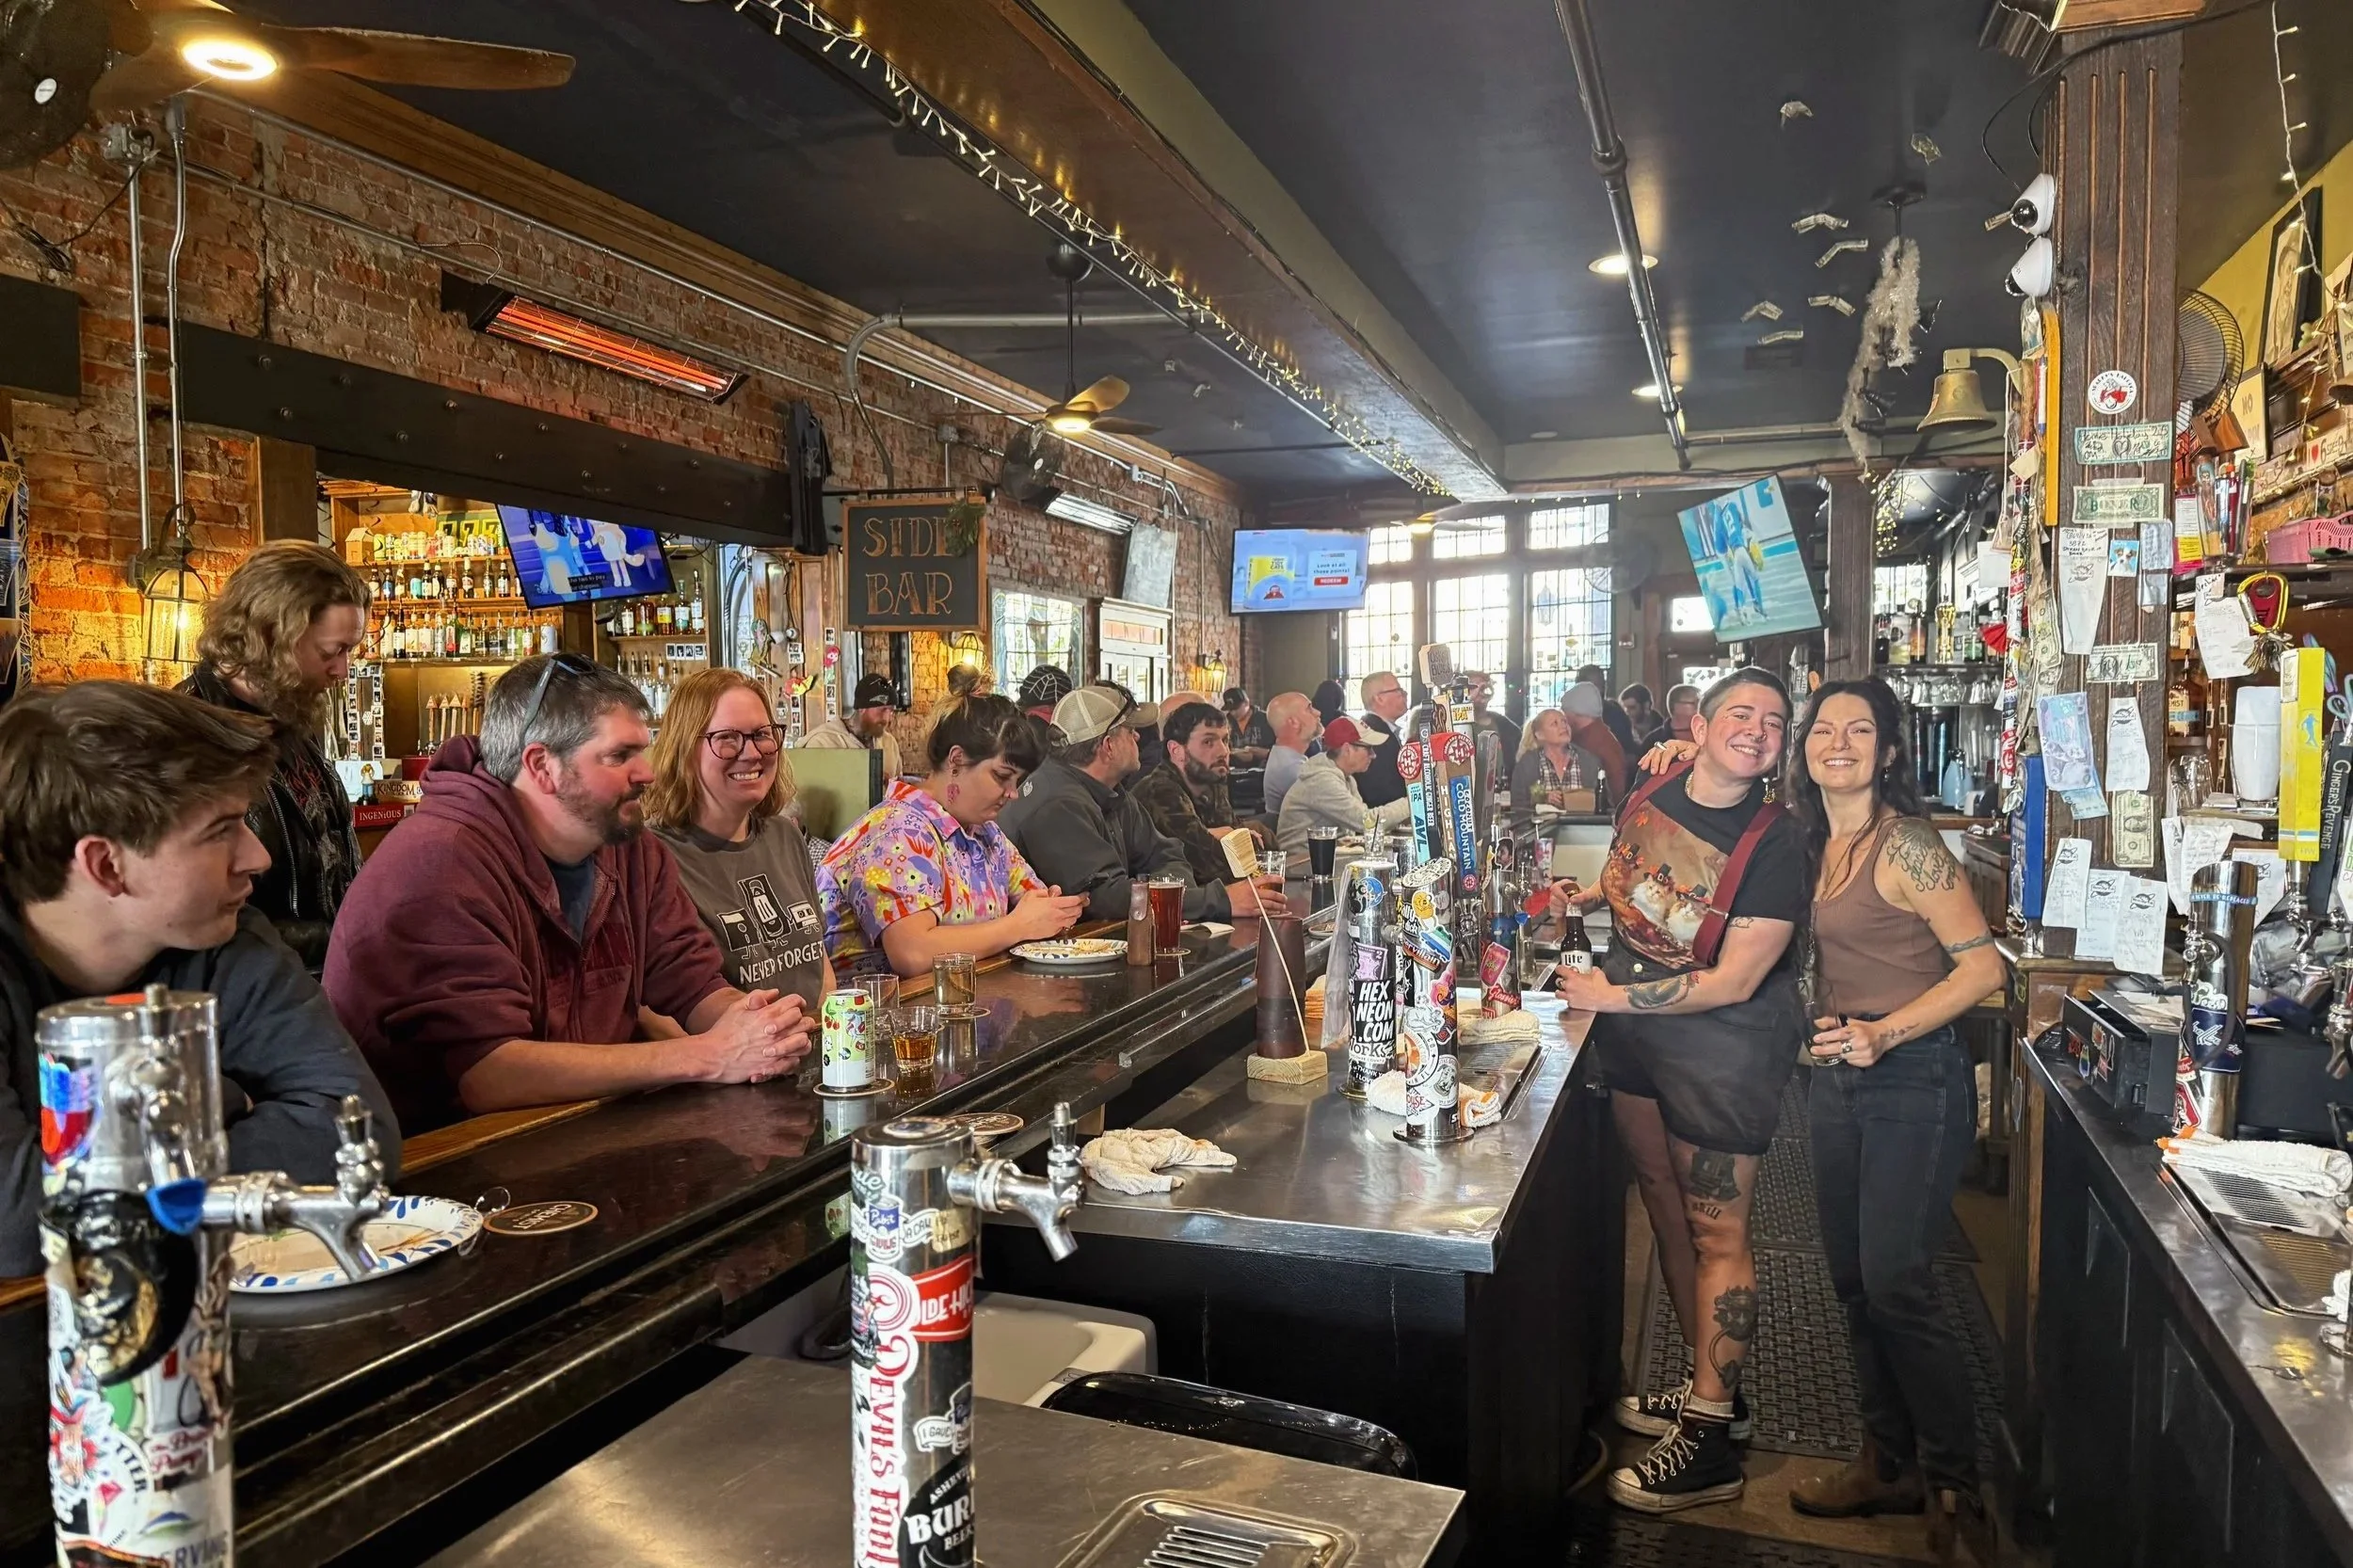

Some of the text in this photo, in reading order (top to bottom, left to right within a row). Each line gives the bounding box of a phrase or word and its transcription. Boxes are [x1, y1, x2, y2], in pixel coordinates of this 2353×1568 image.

[865, 570, 953, 616] BAR
[360, 809, 402, 821] INGENIOUS
[1440, 785, 1457, 862] HIGHLAN
[1464, 791, 1473, 830] COCONUT
[1414, 813, 1428, 853] AVL
[1455, 782, 1472, 870] COLD MOUNTAIN
[740, 940, 824, 984] NEVER FORGET
[1375, 951, 1384, 959] 2
[1403, 939, 1441, 967] ervillain
[1563, 953, 1583, 967] Lite
[1359, 980, 1391, 1001] HEX
[1355, 1000, 1394, 1022] NEON
[1358, 1020, 1394, 1043] .COM
[1357, 1064, 1378, 1077] THANK
[870, 1208, 896, 1227] Pabst
[921, 1294, 950, 1326] LDE
[929, 1464, 970, 1505] ASHEV
[904, 1495, 972, 1545] BUR
